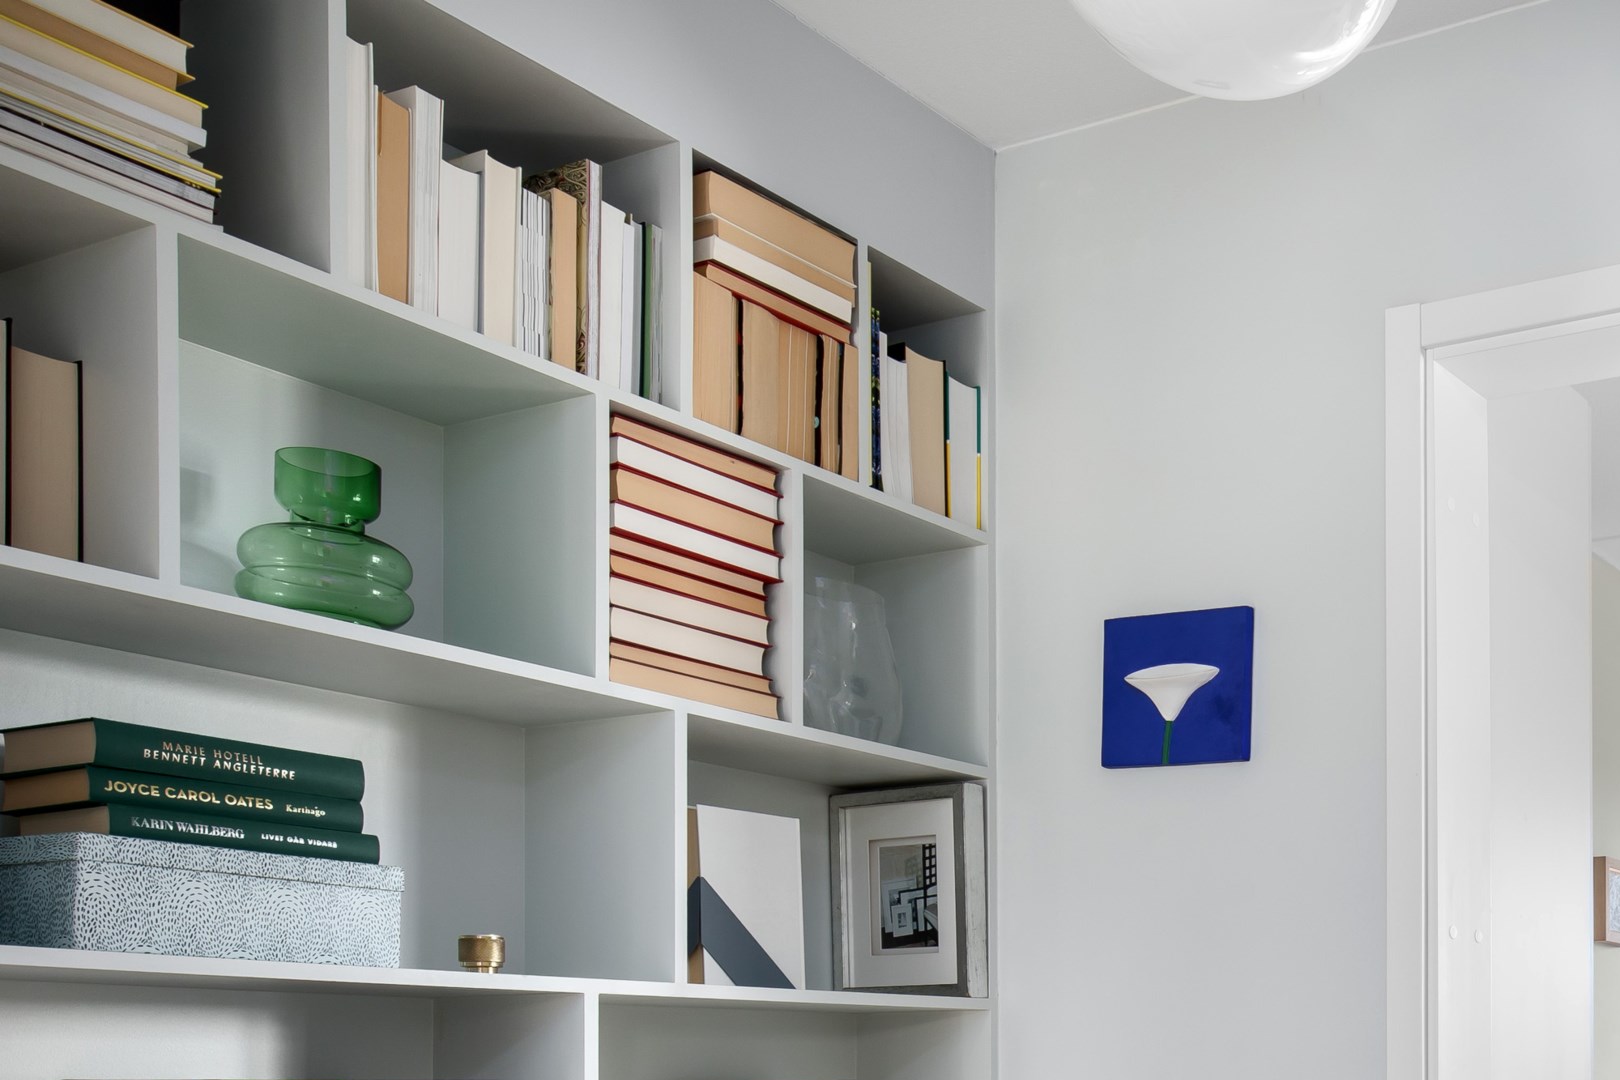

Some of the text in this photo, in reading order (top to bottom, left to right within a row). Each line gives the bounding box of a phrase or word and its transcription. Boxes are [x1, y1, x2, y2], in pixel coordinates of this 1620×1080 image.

[143, 748, 296, 780] BENNETT ANGLETERRE
[162, 741, 263, 766] MARIE HOTELL
[104, 780, 161, 797] JOYCE
[165, 786, 221, 804] CAROL
[225, 794, 273, 810] OATES
[131, 817, 174, 831] KARIN
[176, 821, 245, 839] WAHLBERG
[307, 838, 338, 848] VIDARE
